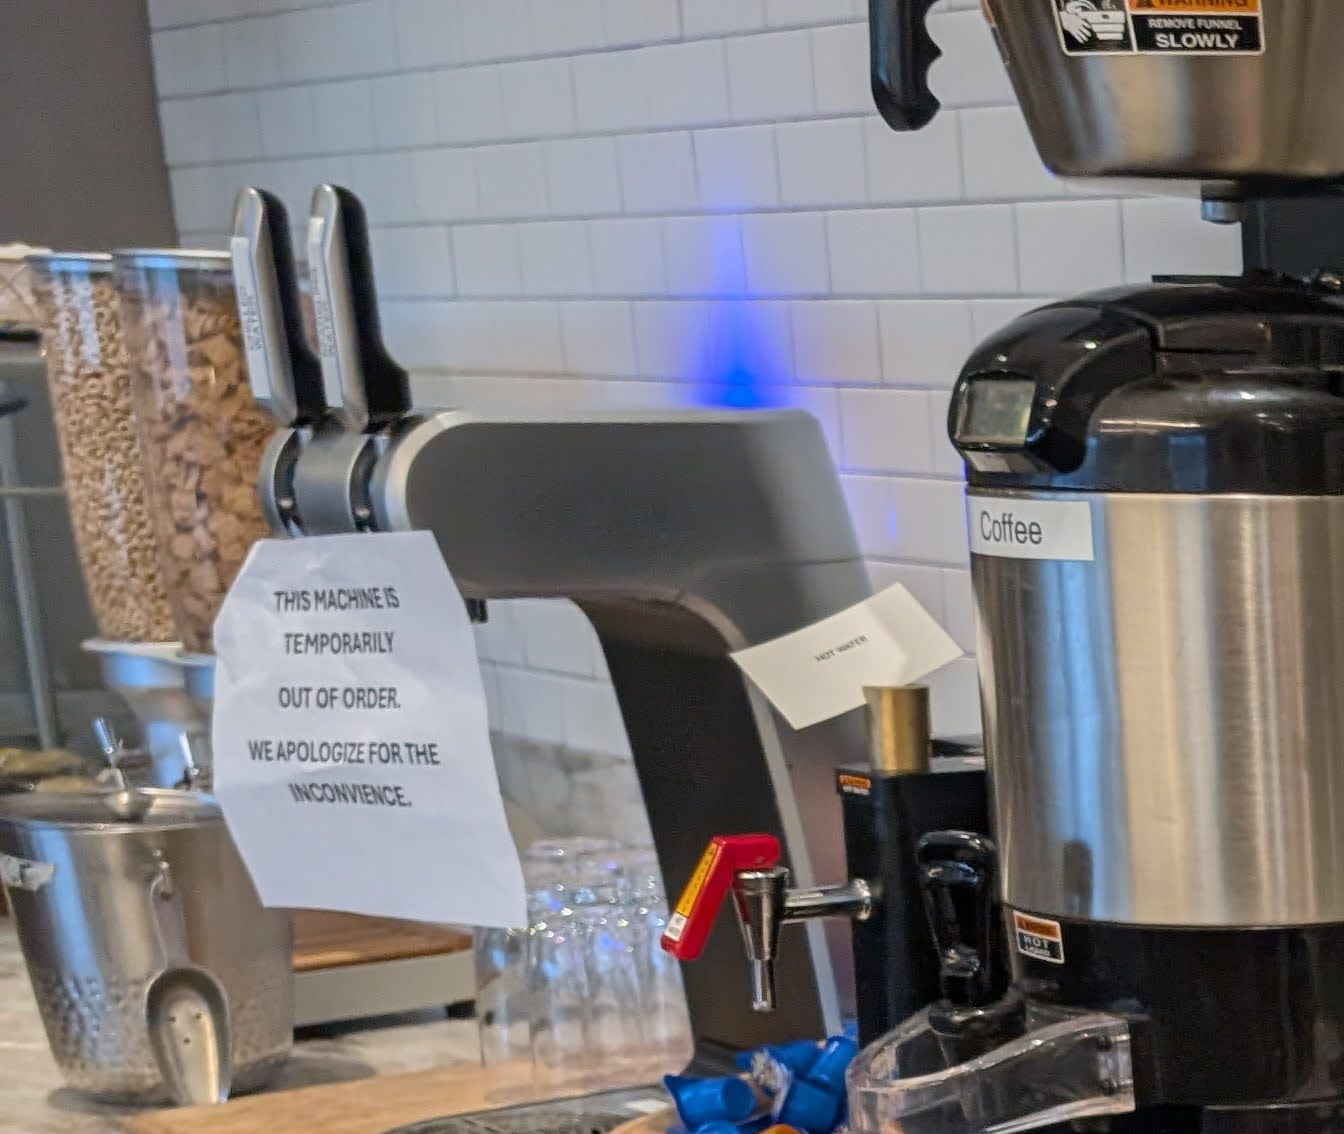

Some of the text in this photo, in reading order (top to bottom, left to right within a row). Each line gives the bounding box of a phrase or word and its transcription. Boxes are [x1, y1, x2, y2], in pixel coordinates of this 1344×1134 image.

[1155, 32, 1239, 48] SLOWLY
[980, 509, 1043, 545] Coffee
[273, 586, 400, 612] THIS MACHINE IS
[284, 631, 394, 655] TEMPORARILY
[278, 686, 401, 709] OUT OF ORDER.
[249, 740, 441, 765] WE APOLOGIZE FOR THE
[288, 782, 413, 808] INCONVIENCE.
